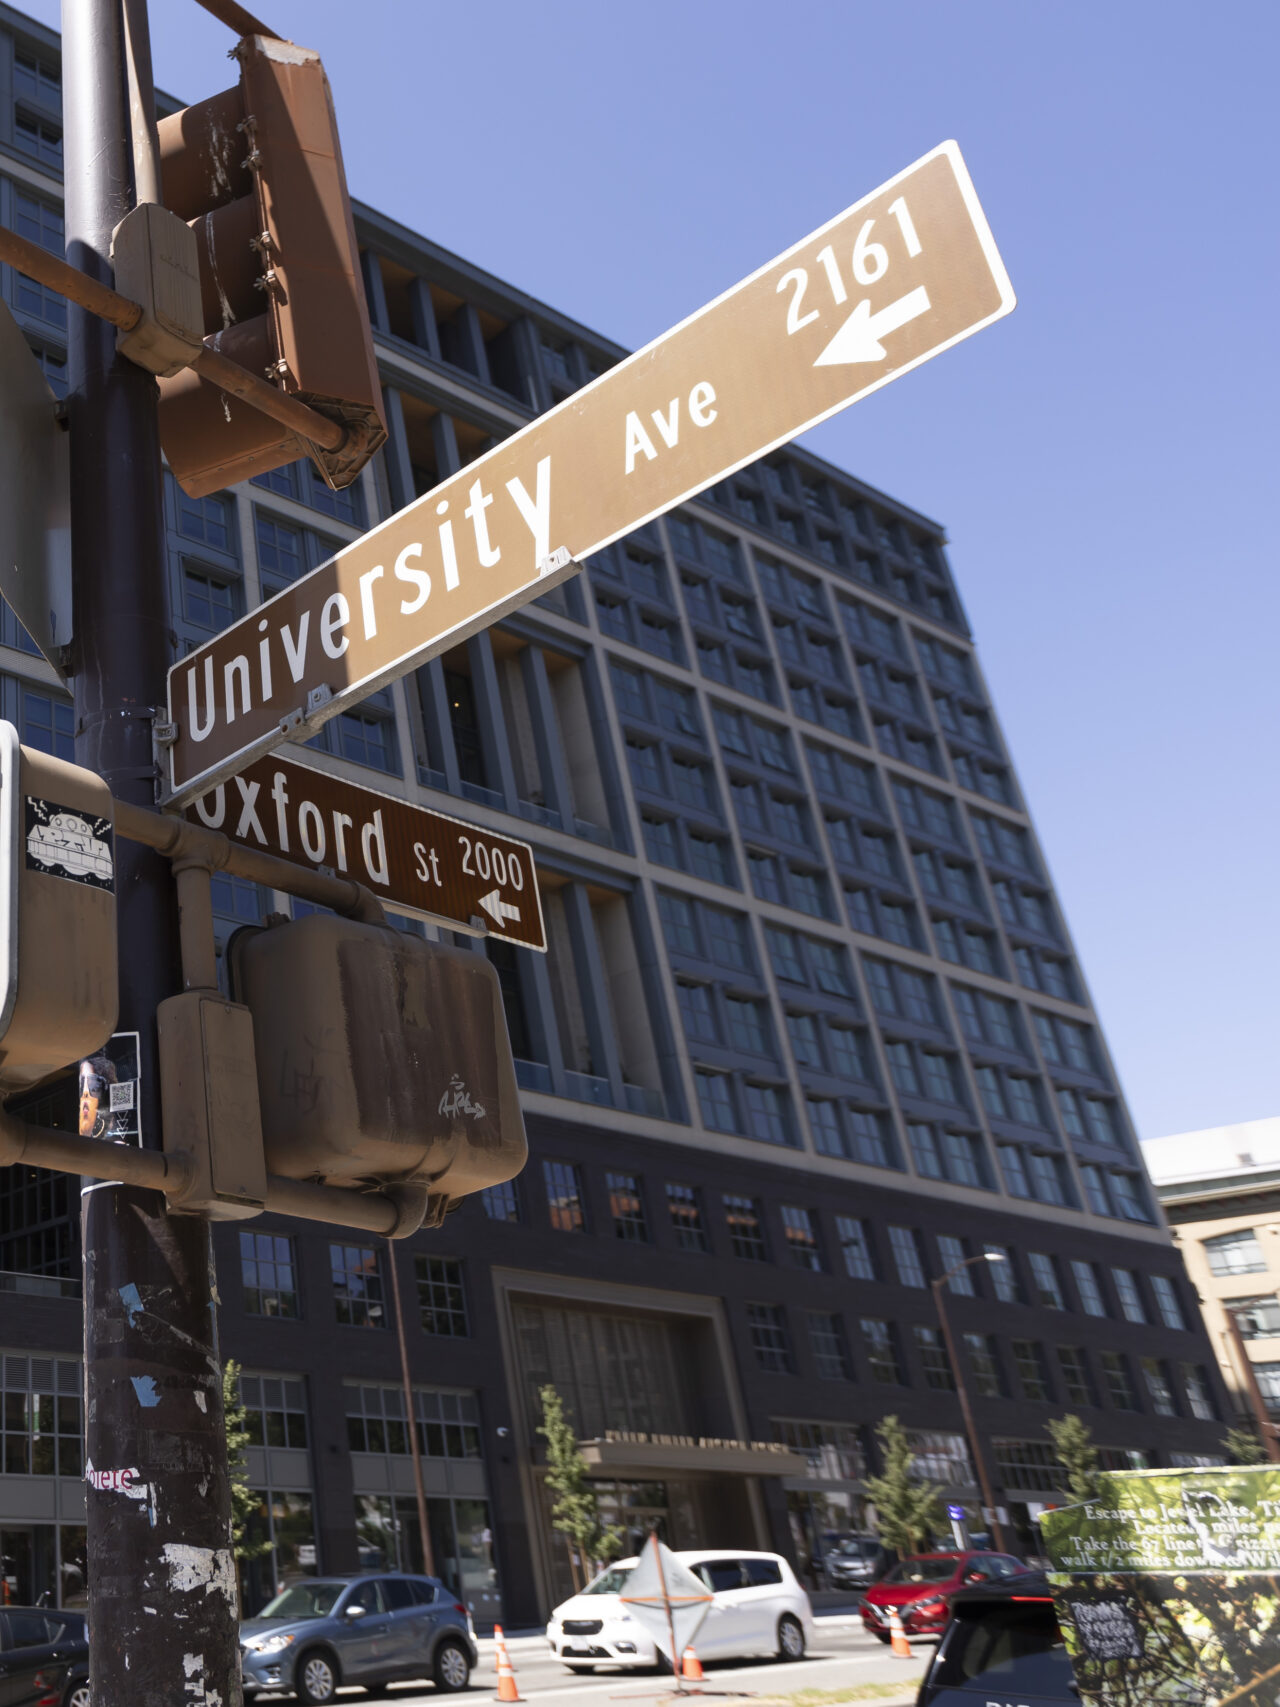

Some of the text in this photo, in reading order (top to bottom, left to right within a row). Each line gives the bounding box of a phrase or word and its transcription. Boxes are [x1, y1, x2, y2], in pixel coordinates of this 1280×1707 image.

[776, 196, 923, 335] 2161
[187, 381, 718, 742] University Ave
[413, 841, 442, 887] St
[458, 836, 524, 891] 2000
[1084, 1505, 1136, 1523] Escape
[1140, 1507, 1158, 1520] to
[1213, 1518, 1260, 1534] miles
[1061, 1551, 1096, 1567] walk
[1127, 1551, 1170, 1567] miles
[1070, 1536, 1109, 1551] Take
[1112, 1535, 1138, 1551] the
[1141, 1537, 1160, 1552] 67
[1164, 1535, 1196, 1551] line
